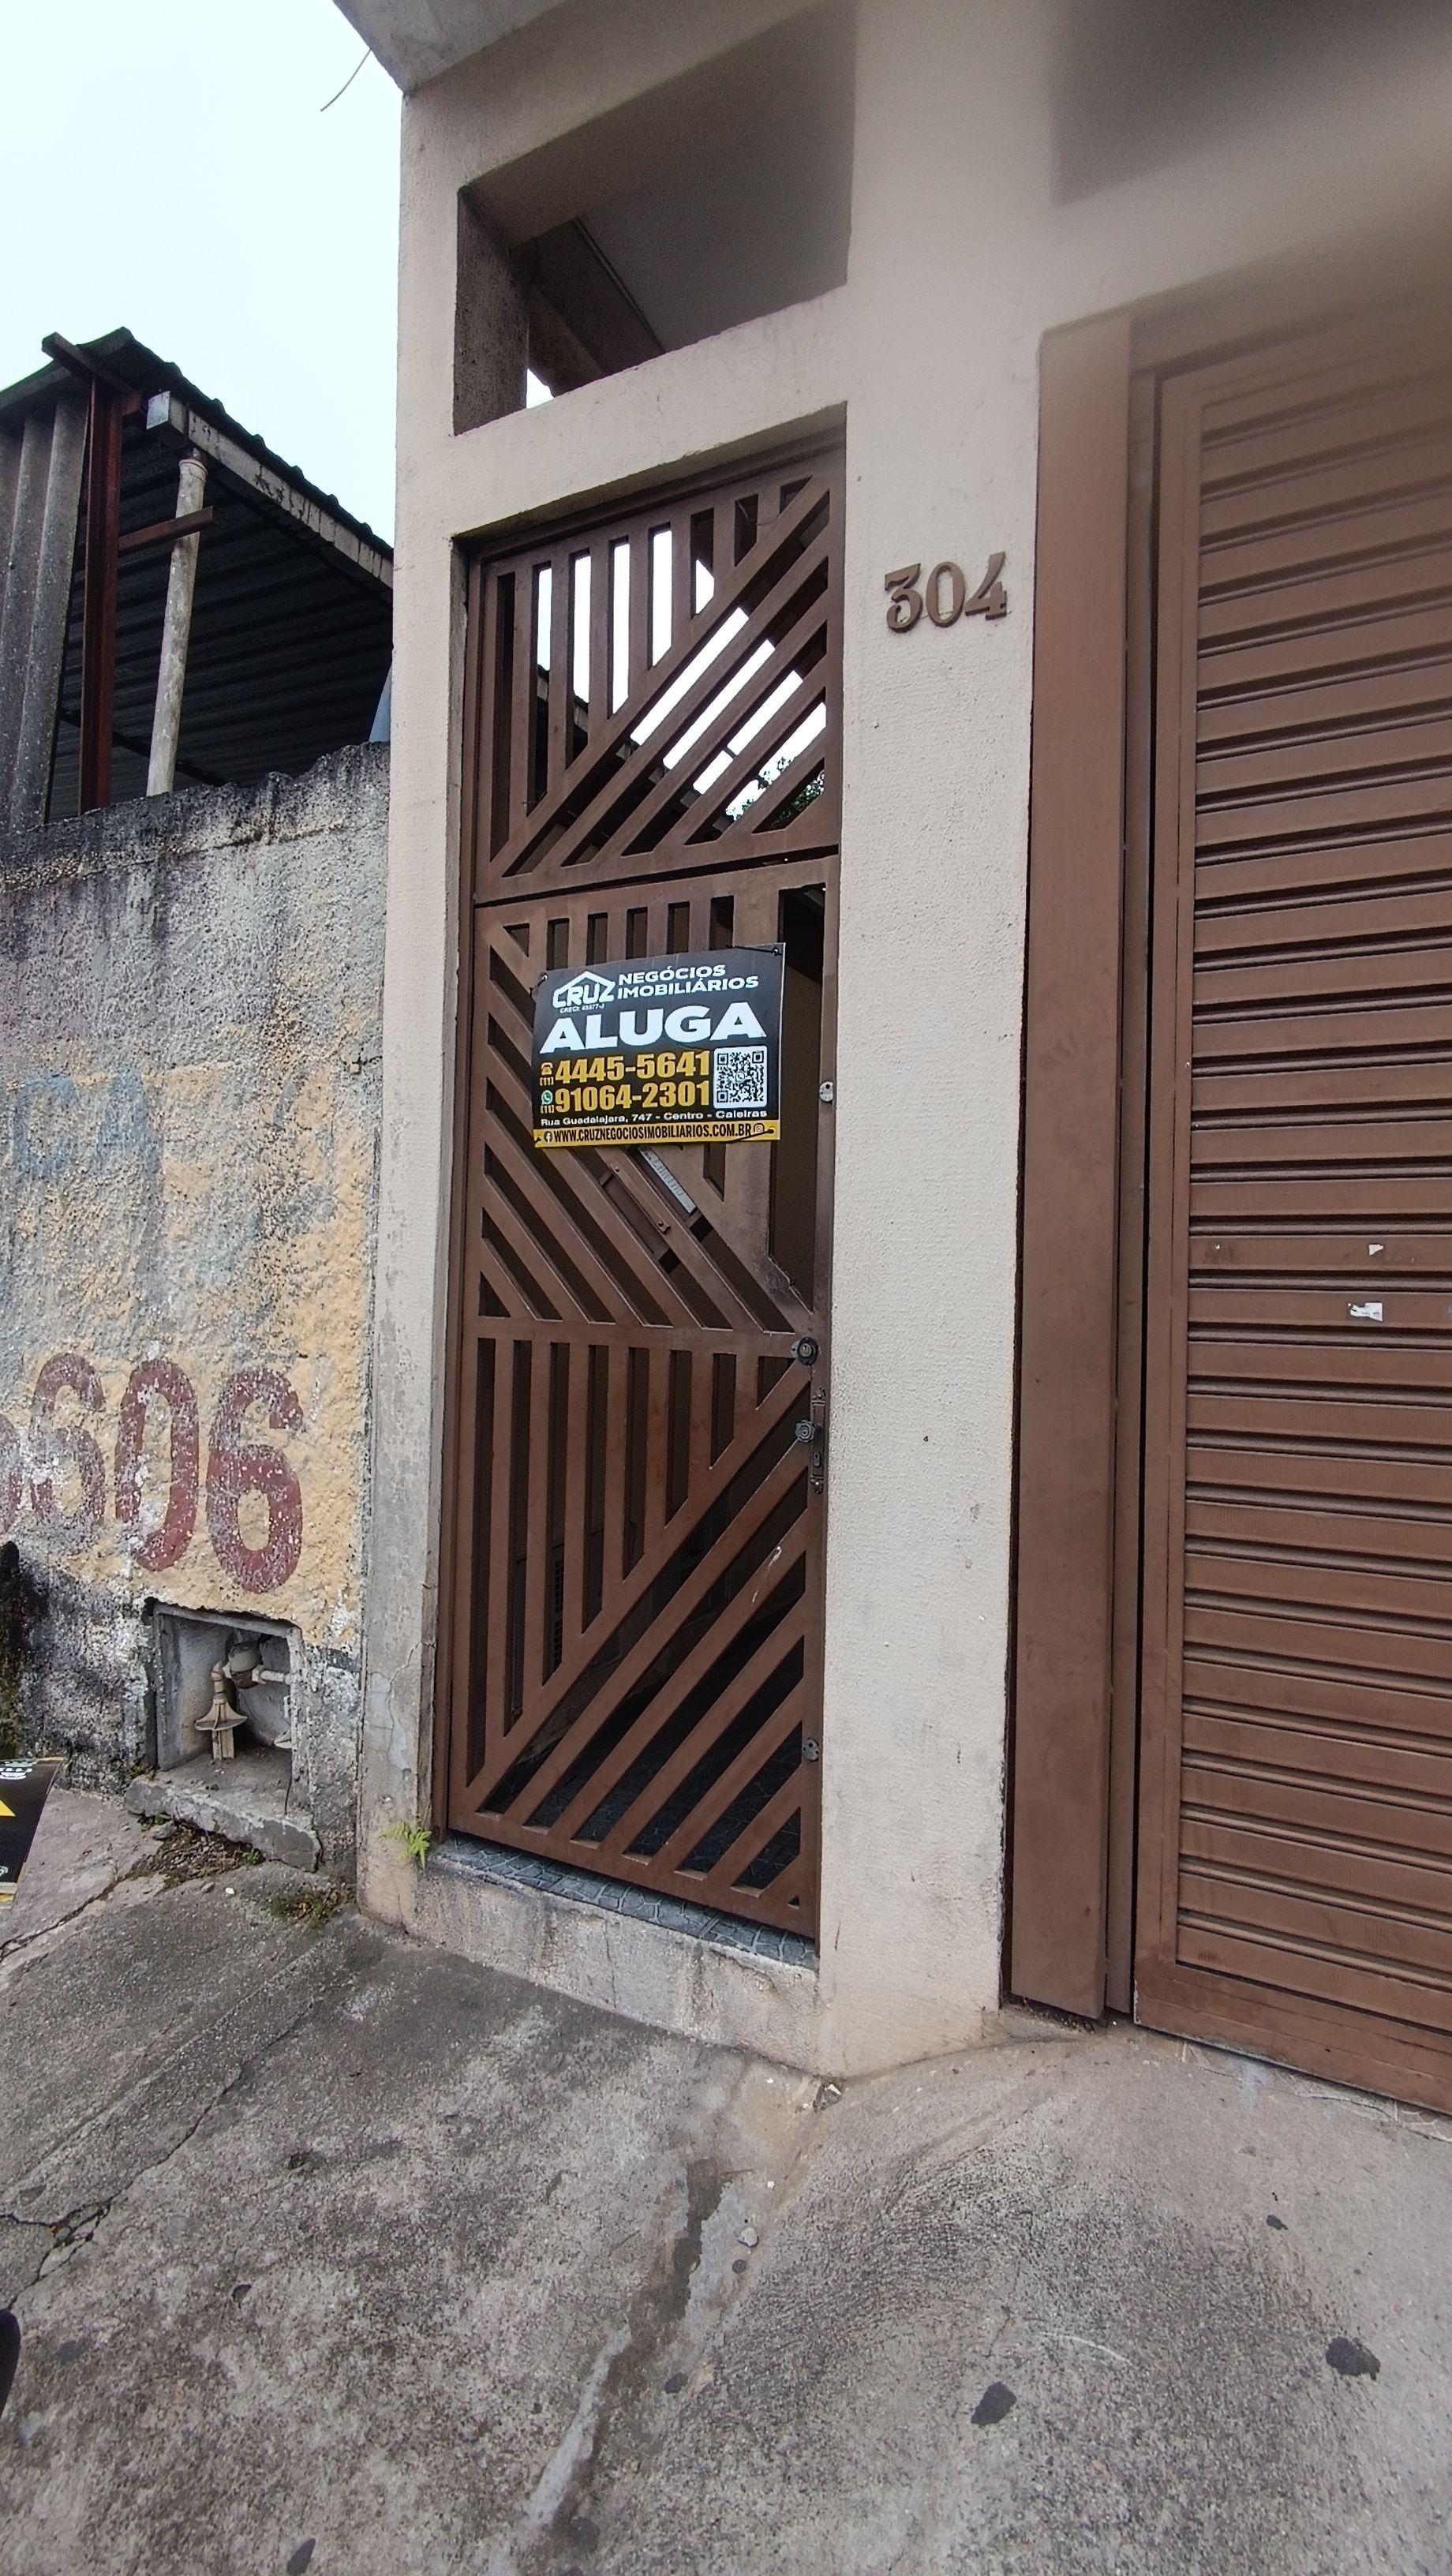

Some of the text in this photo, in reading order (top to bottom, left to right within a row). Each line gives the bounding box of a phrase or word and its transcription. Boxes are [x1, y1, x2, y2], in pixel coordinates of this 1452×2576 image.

[885, 551, 1007, 632] 304
[618, 975, 759, 1000] IMOBILIÁRIOS
[619, 964, 726, 986] NEGÓCIOS
[552, 980, 616, 1009] CRUZ
[540, 1002, 767, 1054] ALUGA
[555, 1050, 710, 1084] 4445-5641
[555, 1080, 710, 1113] 91064-2301
[541, 1118, 560, 1127] Rua
[563, 1114, 629, 1125] Guadalajara,
[631, 1113, 653, 1121] 747
[664, 1111, 704, 1121] Centro
[553, 1123, 752, 1143] WWW.CRUZNEGOCIOSIMOBILIARIOS.COM.BR
